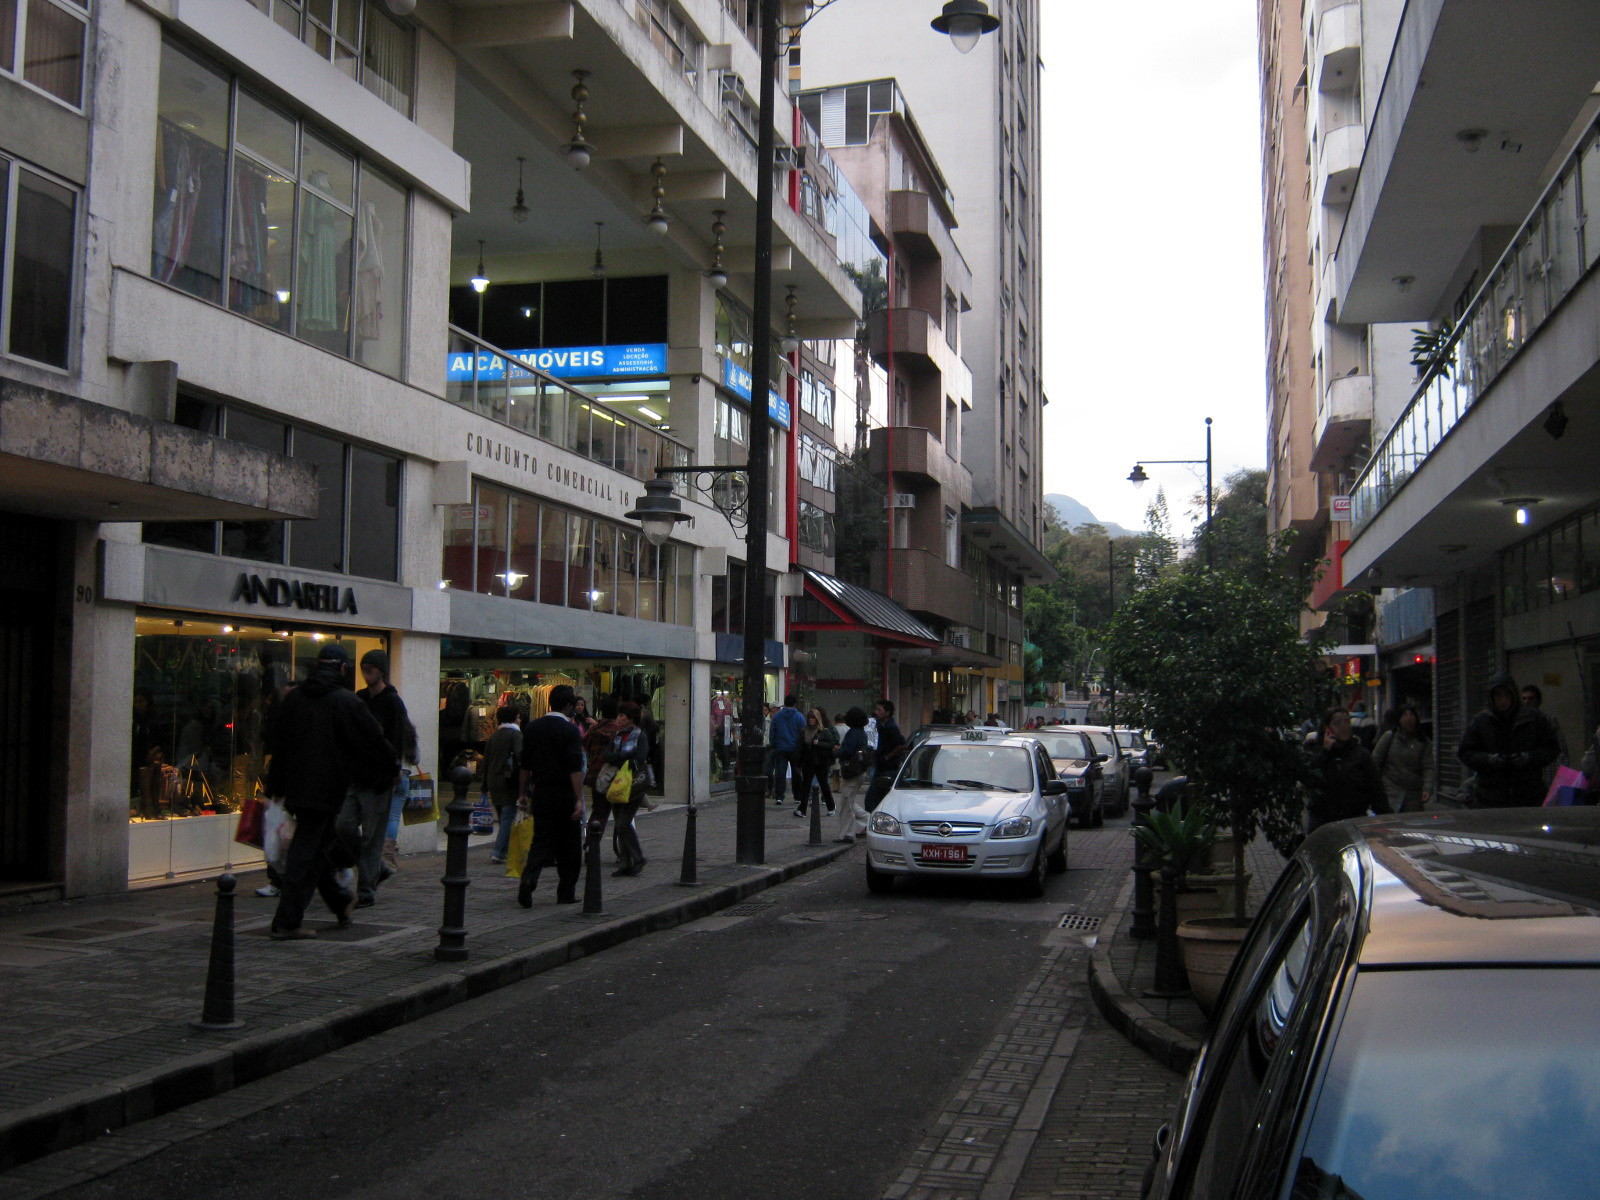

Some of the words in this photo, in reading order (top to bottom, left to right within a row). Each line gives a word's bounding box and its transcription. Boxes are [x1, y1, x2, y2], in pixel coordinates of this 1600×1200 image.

[451, 355, 504, 371] AICA
[467, 432, 538, 475] CONJUNTO
[547, 463, 612, 501] COMERCIAL
[620, 490, 629, 507] 16
[76, 585, 92, 604] 90
[229, 573, 358, 615] ANDARELLA
[965, 731, 983, 740] TAXI
